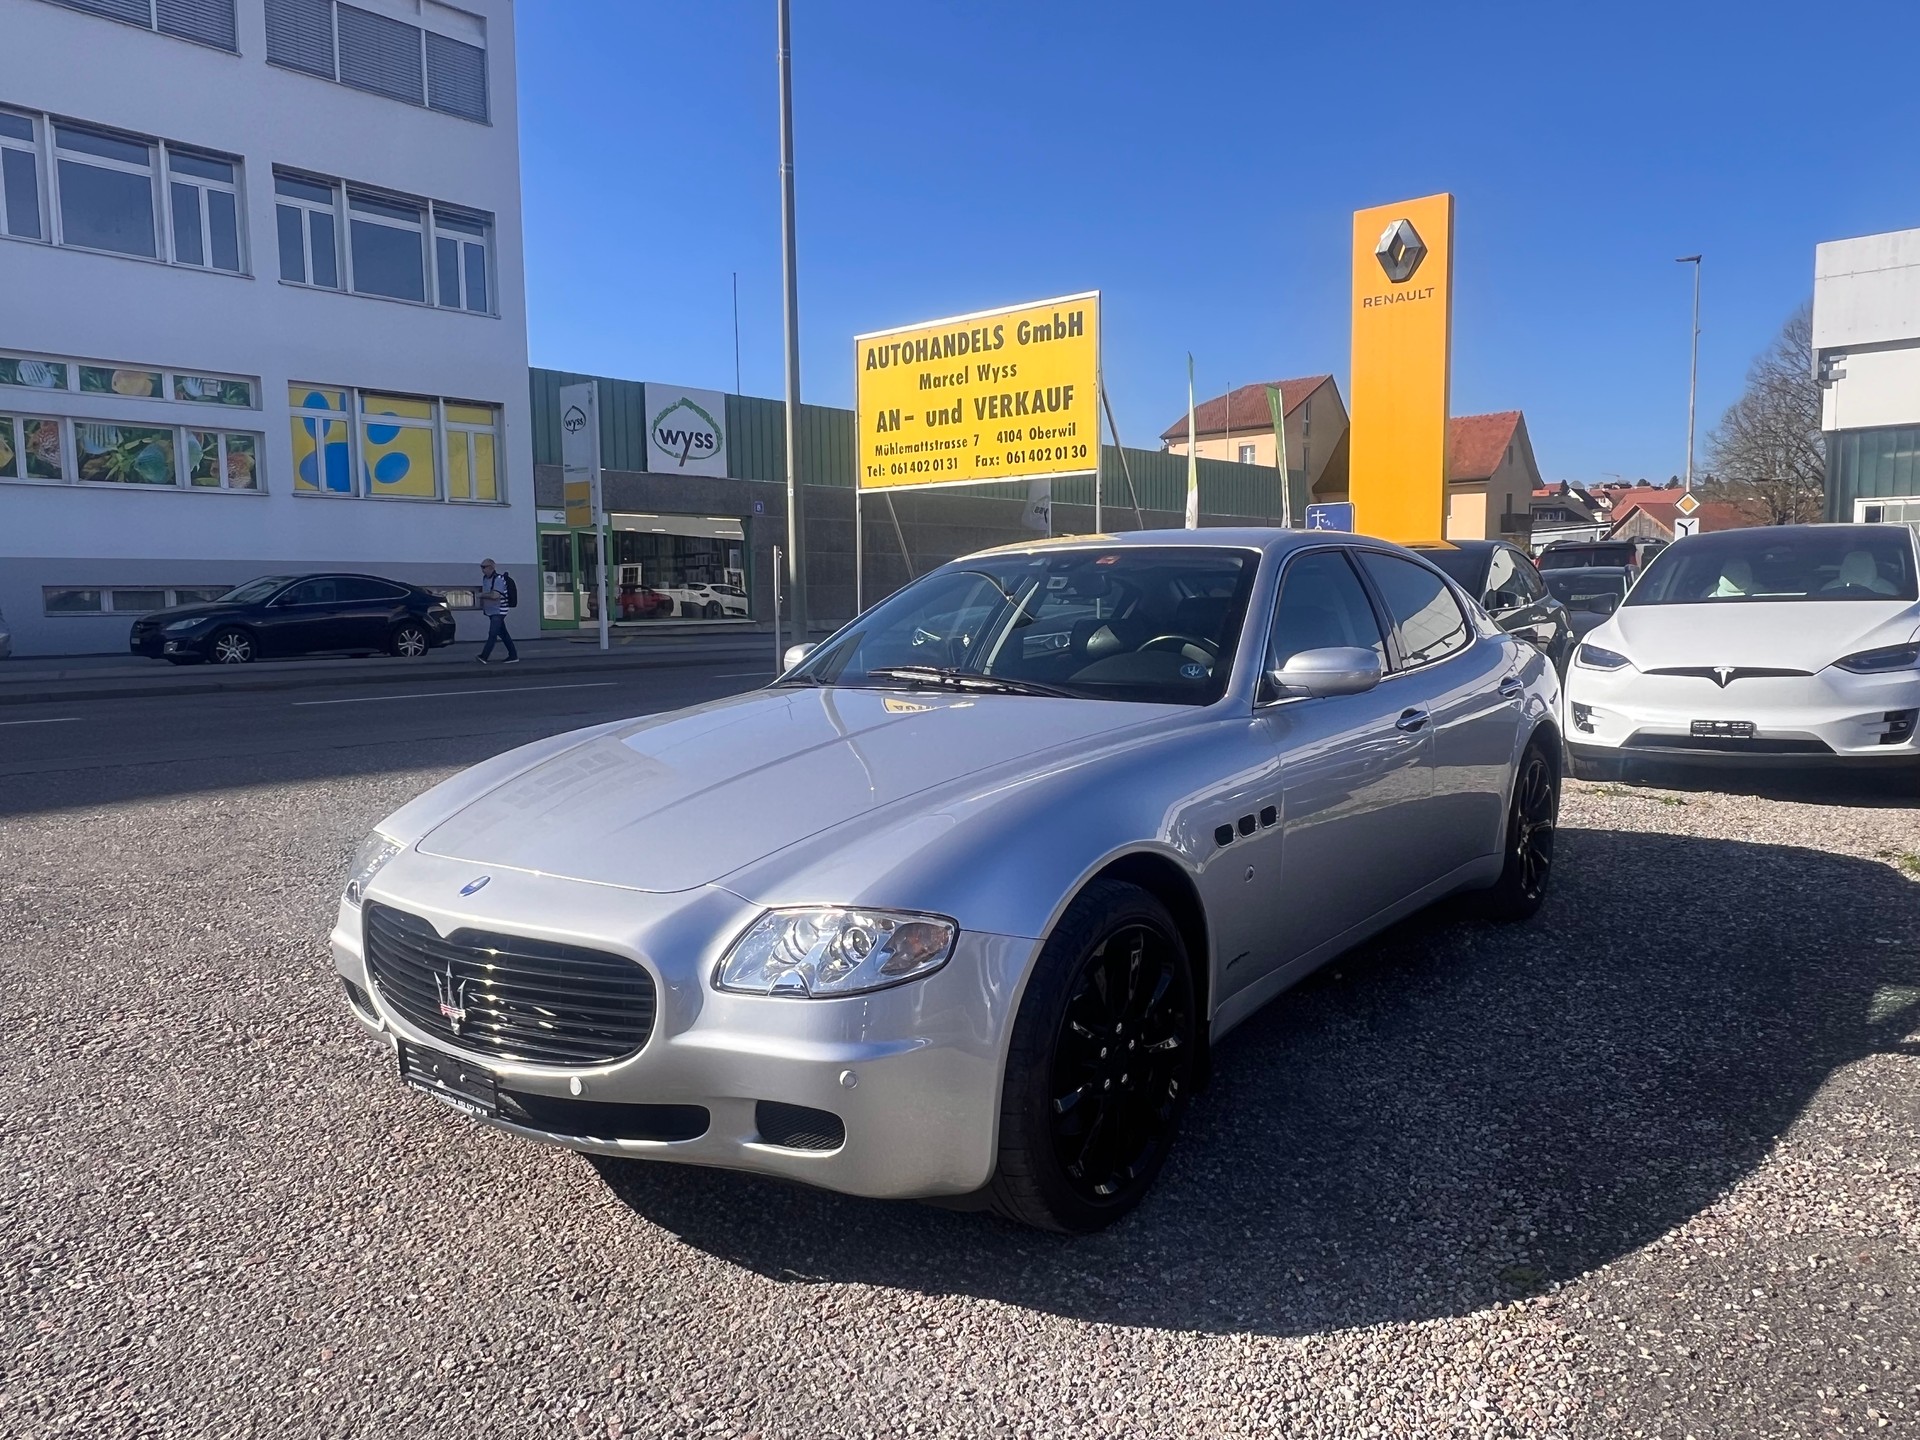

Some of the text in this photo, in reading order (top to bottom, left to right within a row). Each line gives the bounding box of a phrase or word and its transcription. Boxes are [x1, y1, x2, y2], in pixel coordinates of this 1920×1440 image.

[1363, 287, 1435, 308] RENAULT
[866, 310, 1083, 371] AUTOHANDELS GmbH
[919, 363, 1018, 391] Marcel Wyss
[925, 398, 963, 428] und
[973, 384, 1075, 421] VERKAUF
[565, 417, 584, 434] wyss
[875, 422, 1077, 457] Mühlemattstrasse 7 4104 Oberwil
[658, 428, 714, 468] wyss
[975, 454, 1000, 468] Fax:
[866, 463, 886, 478] Tel:
